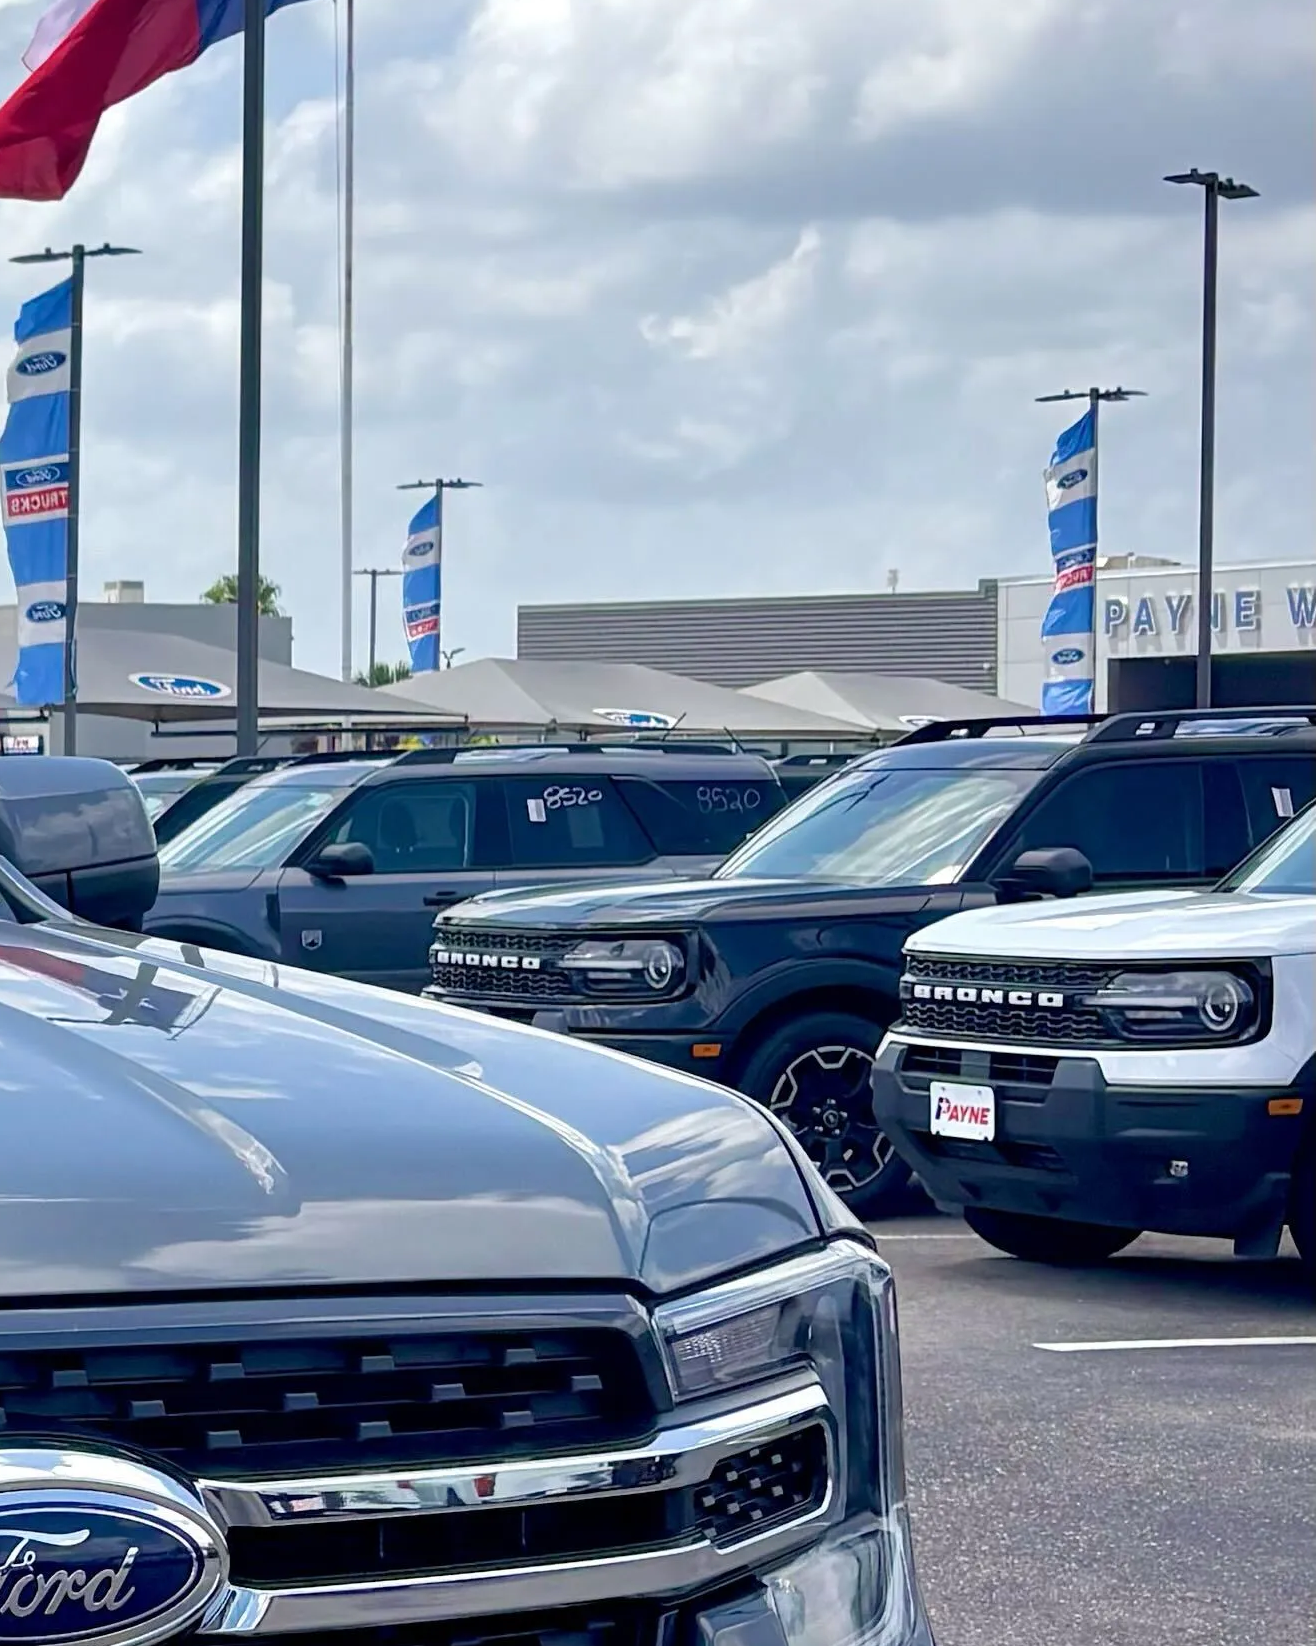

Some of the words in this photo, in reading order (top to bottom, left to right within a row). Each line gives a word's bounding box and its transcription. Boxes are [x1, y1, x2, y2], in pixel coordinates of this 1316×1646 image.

[544, 786, 602, 809] 8520
[437, 951, 540, 969] BRONCO
[913, 984, 1064, 1007] BRONCO
[935, 1097, 990, 1125] PAYNE
